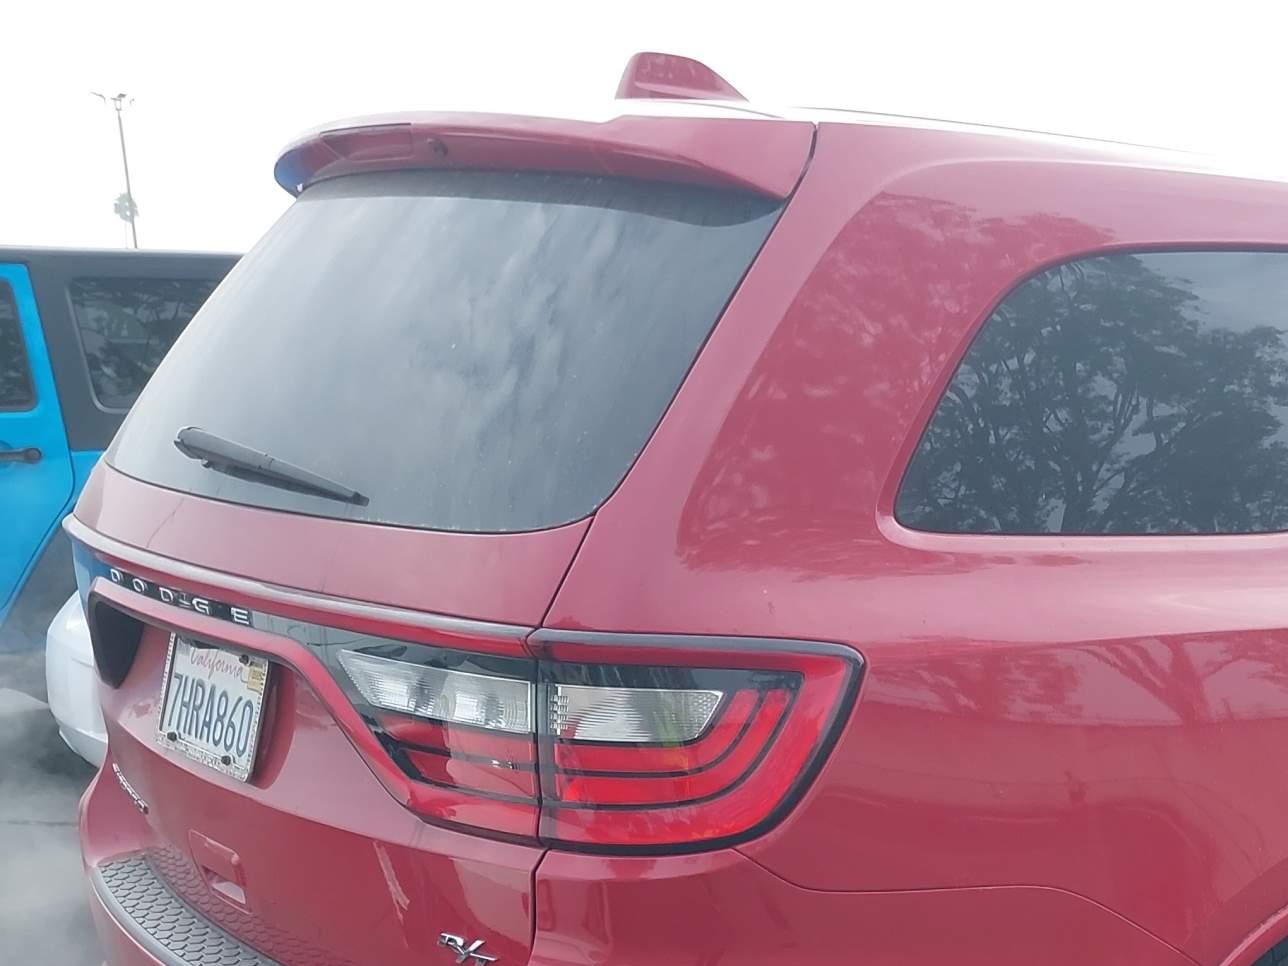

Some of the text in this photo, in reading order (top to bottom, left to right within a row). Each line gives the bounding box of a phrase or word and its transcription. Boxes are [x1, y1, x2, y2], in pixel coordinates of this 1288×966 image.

[110, 568, 250, 625] DODGE
[190, 647, 244, 679] California
[167, 672, 254, 758] 7HRA860
